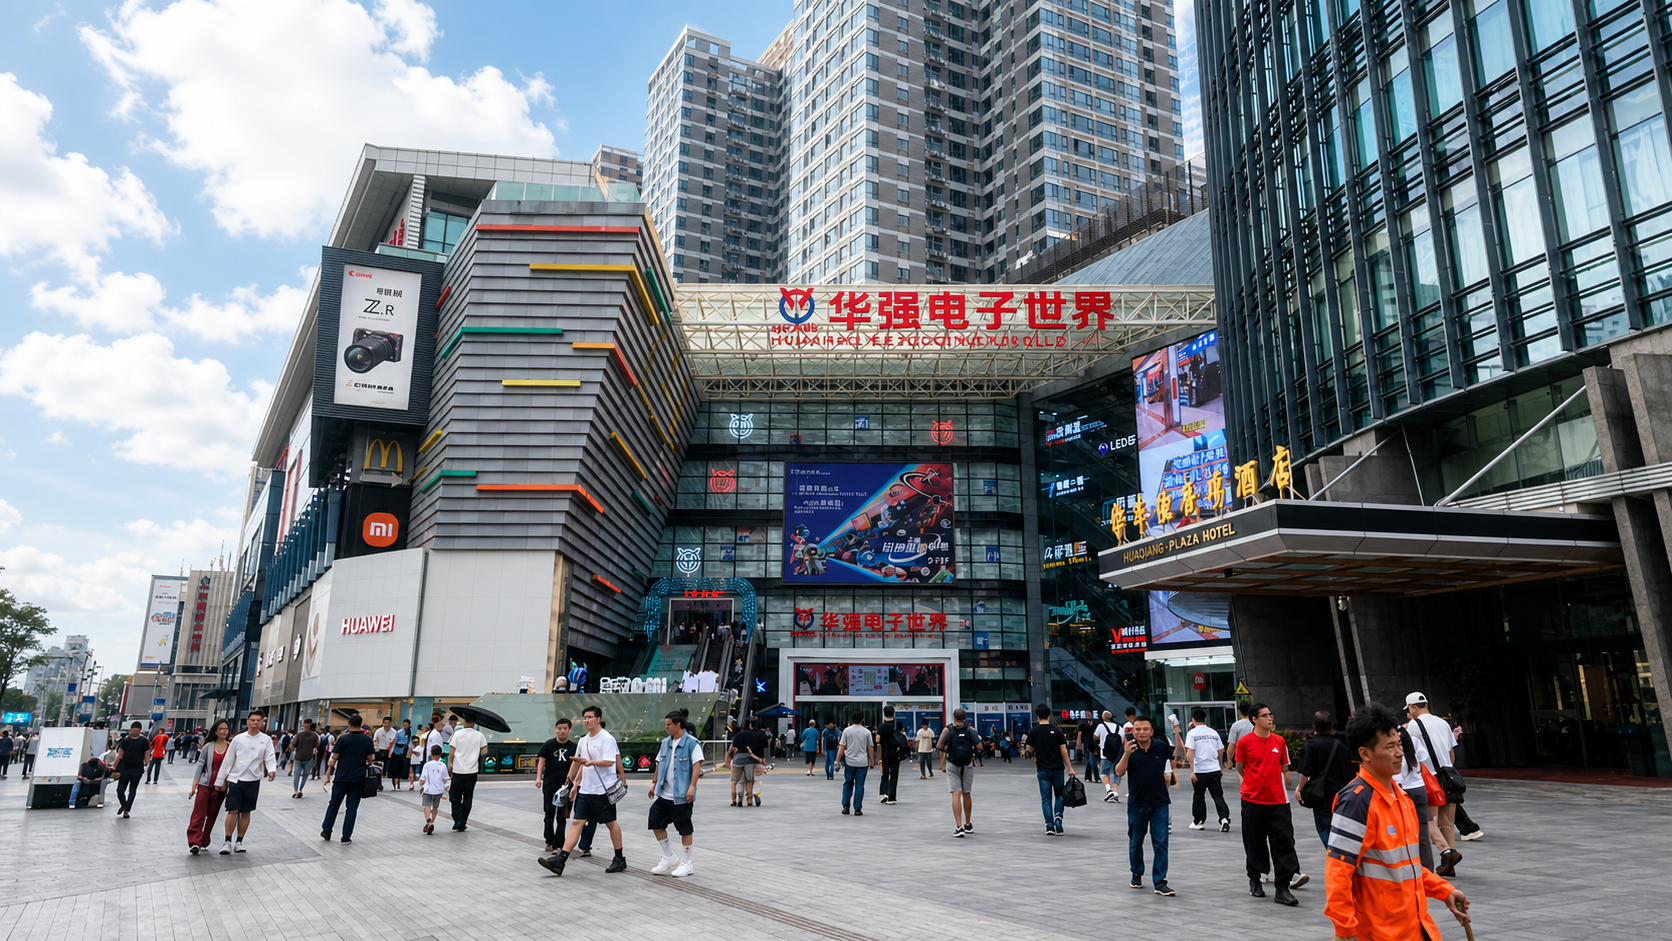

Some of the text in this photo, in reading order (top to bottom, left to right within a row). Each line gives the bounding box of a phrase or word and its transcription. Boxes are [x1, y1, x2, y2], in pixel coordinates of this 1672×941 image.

[829, 290, 1116, 331] 华强电子世界
[1169, 533, 1200, 552] PLAZA
[1202, 522, 1236, 542] HOTEL
[341, 614, 395, 635] HUAWEI
[820, 612, 947, 632] 华强电子世界
